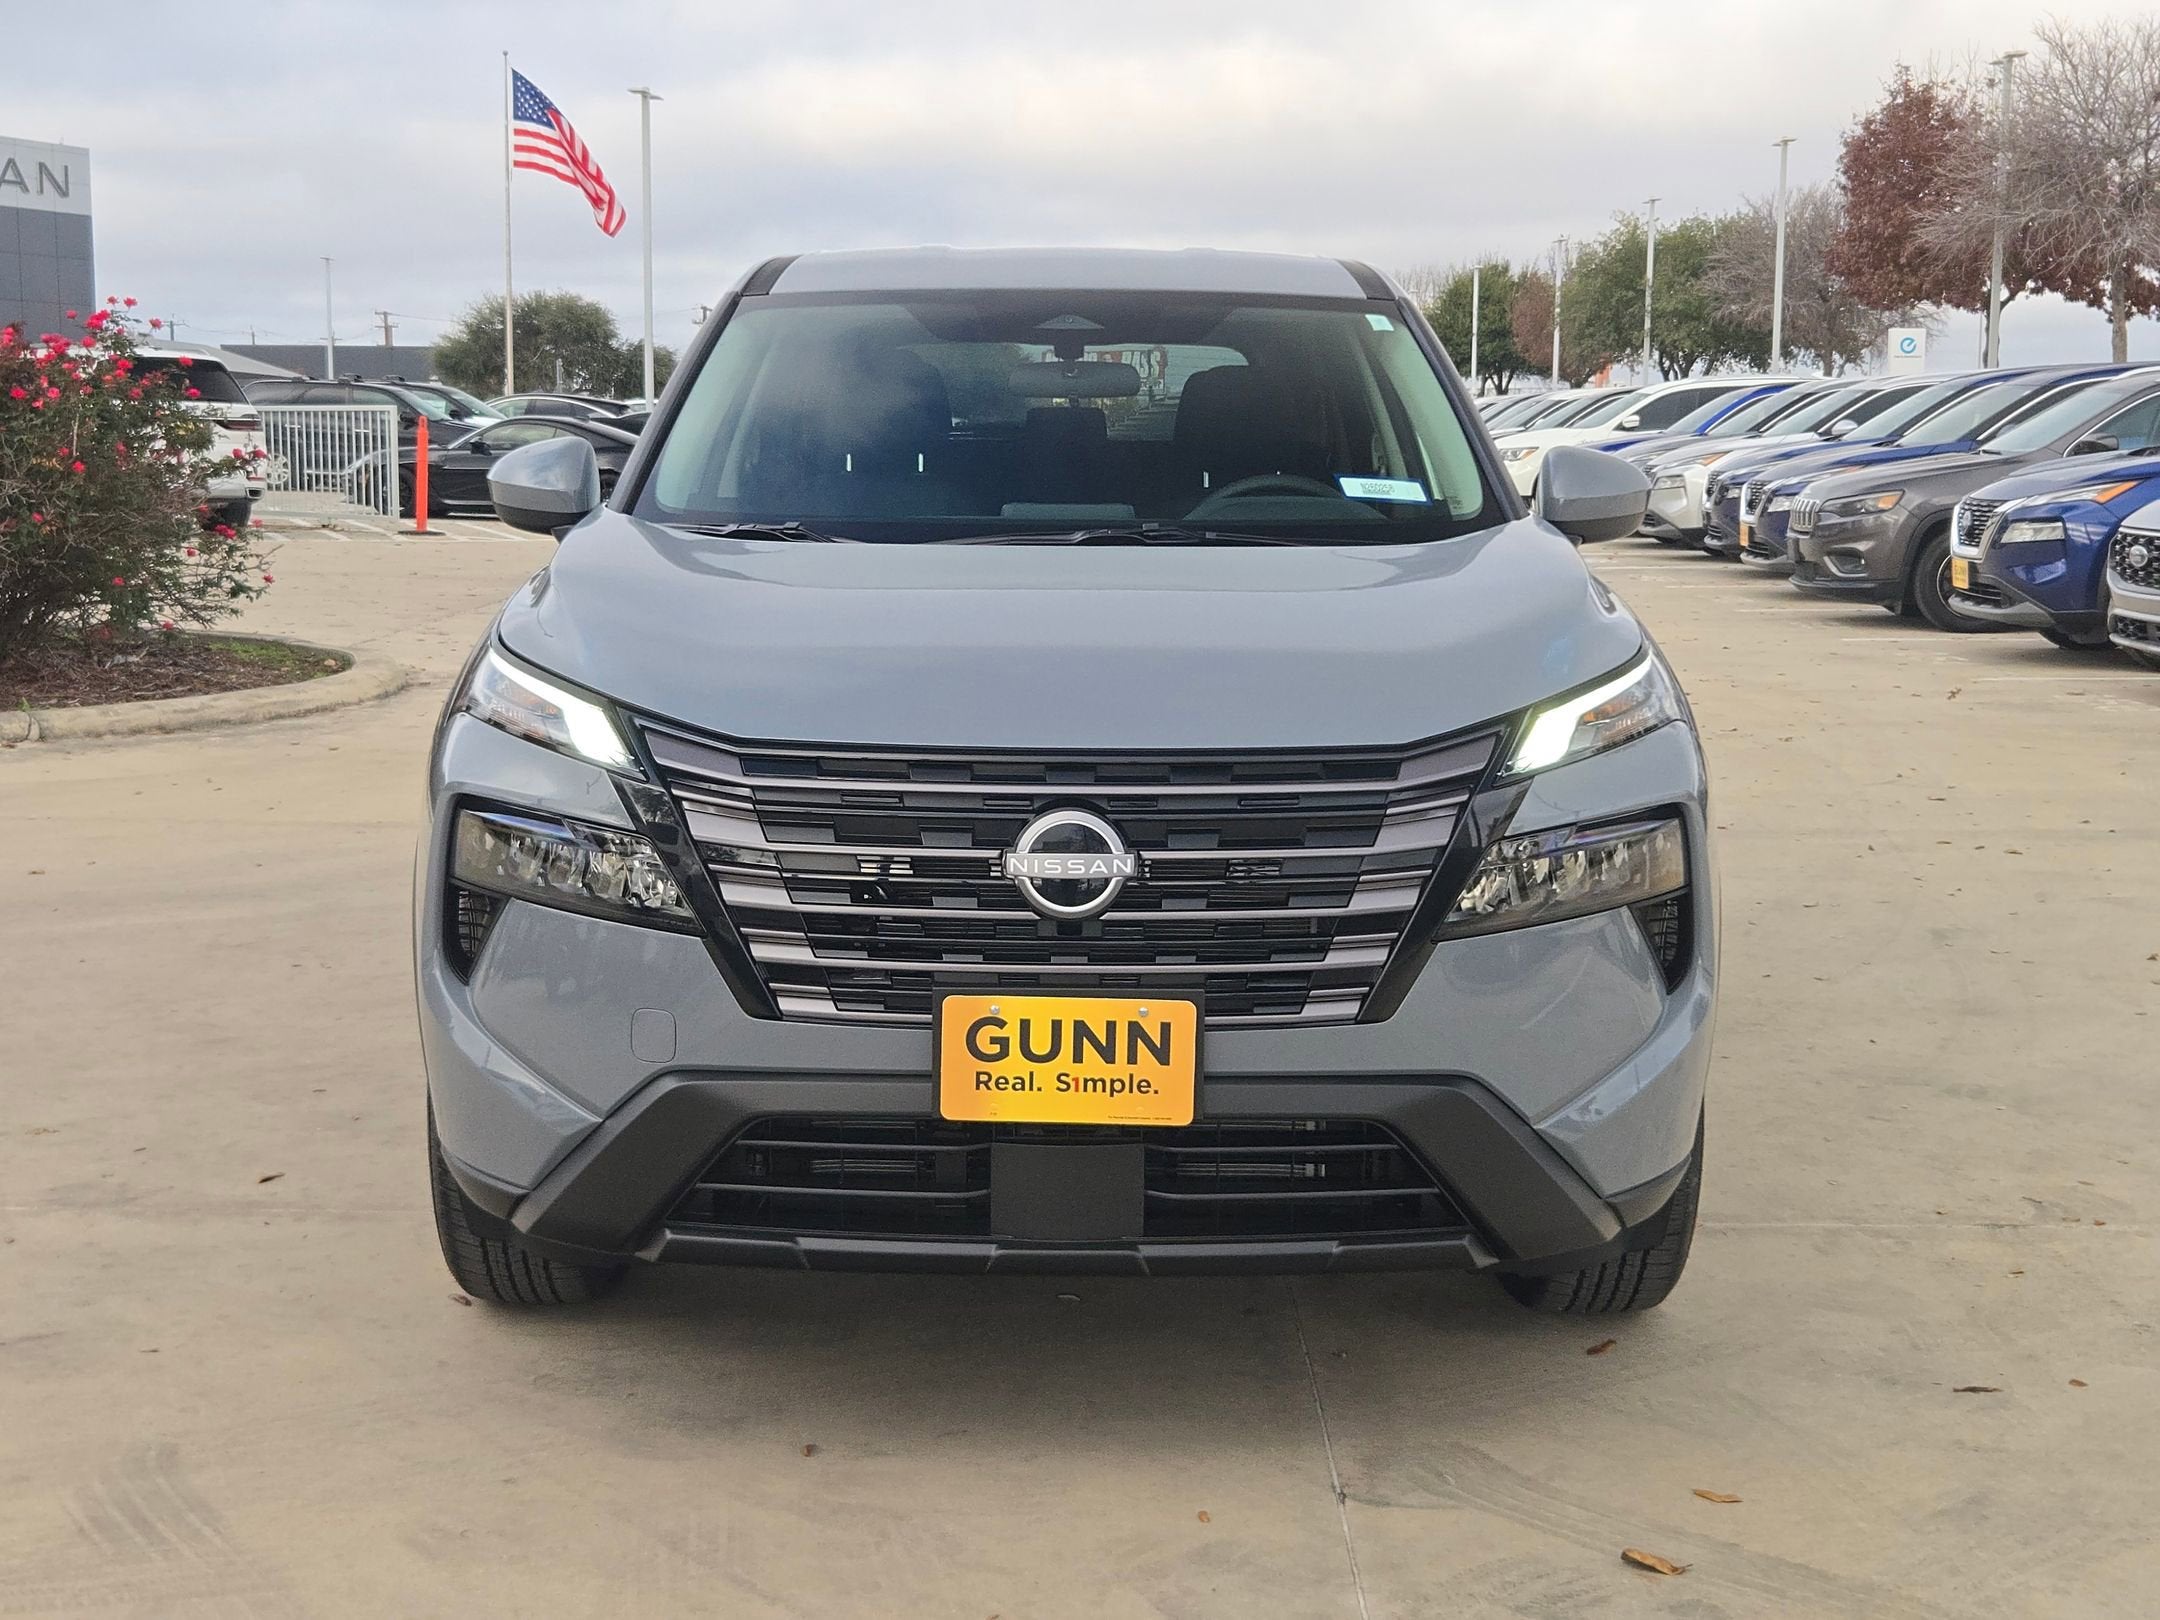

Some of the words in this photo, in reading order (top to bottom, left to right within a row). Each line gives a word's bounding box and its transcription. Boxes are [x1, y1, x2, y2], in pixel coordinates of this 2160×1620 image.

[1009, 858, 1132, 874] NISSAN
[965, 1016, 1172, 1067] GUNN
[975, 1071, 1042, 1092] Real.
